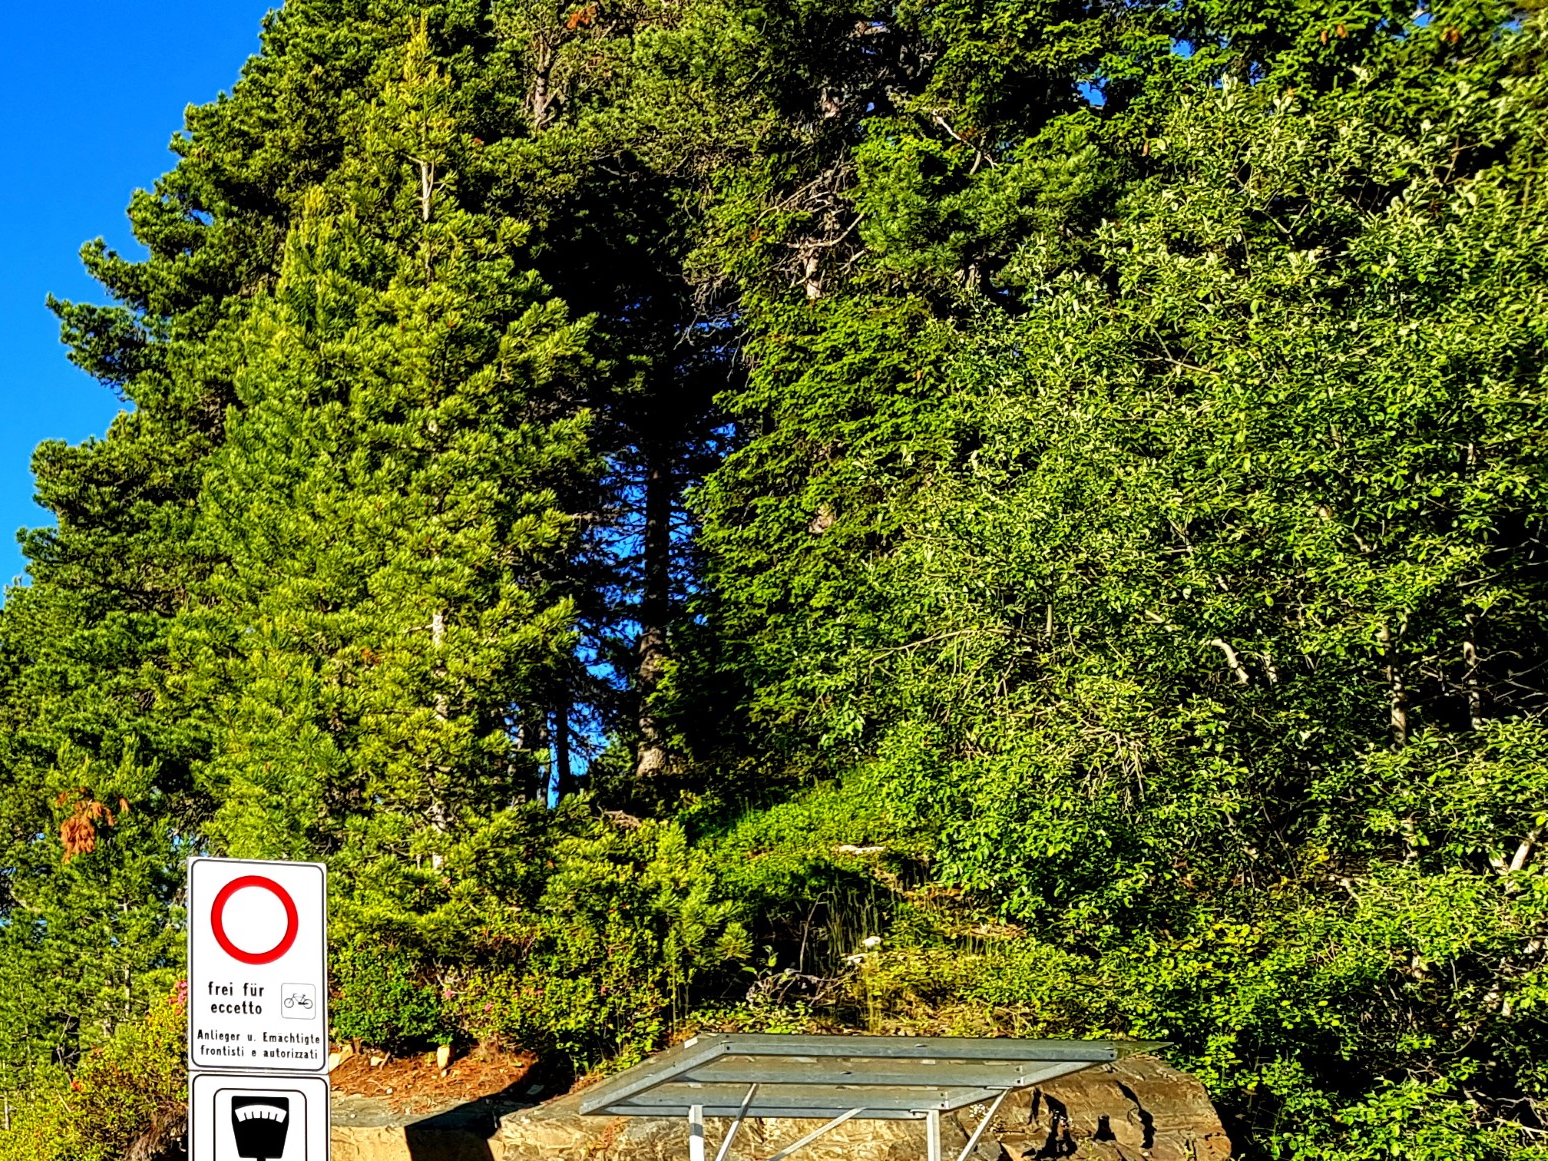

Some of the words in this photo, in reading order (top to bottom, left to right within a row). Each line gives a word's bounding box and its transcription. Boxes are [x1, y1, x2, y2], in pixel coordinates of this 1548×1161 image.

[208, 981, 234, 996] frei
[243, 982, 265, 997] für
[210, 1001, 263, 1015] eccetto
[197, 1029, 241, 1042] Anlieger
[247, 1034, 256, 1042] u.
[200, 1045, 245, 1057] frontisti
[251, 1049, 257, 1057] e
[263, 1048, 318, 1059] autorizzati
